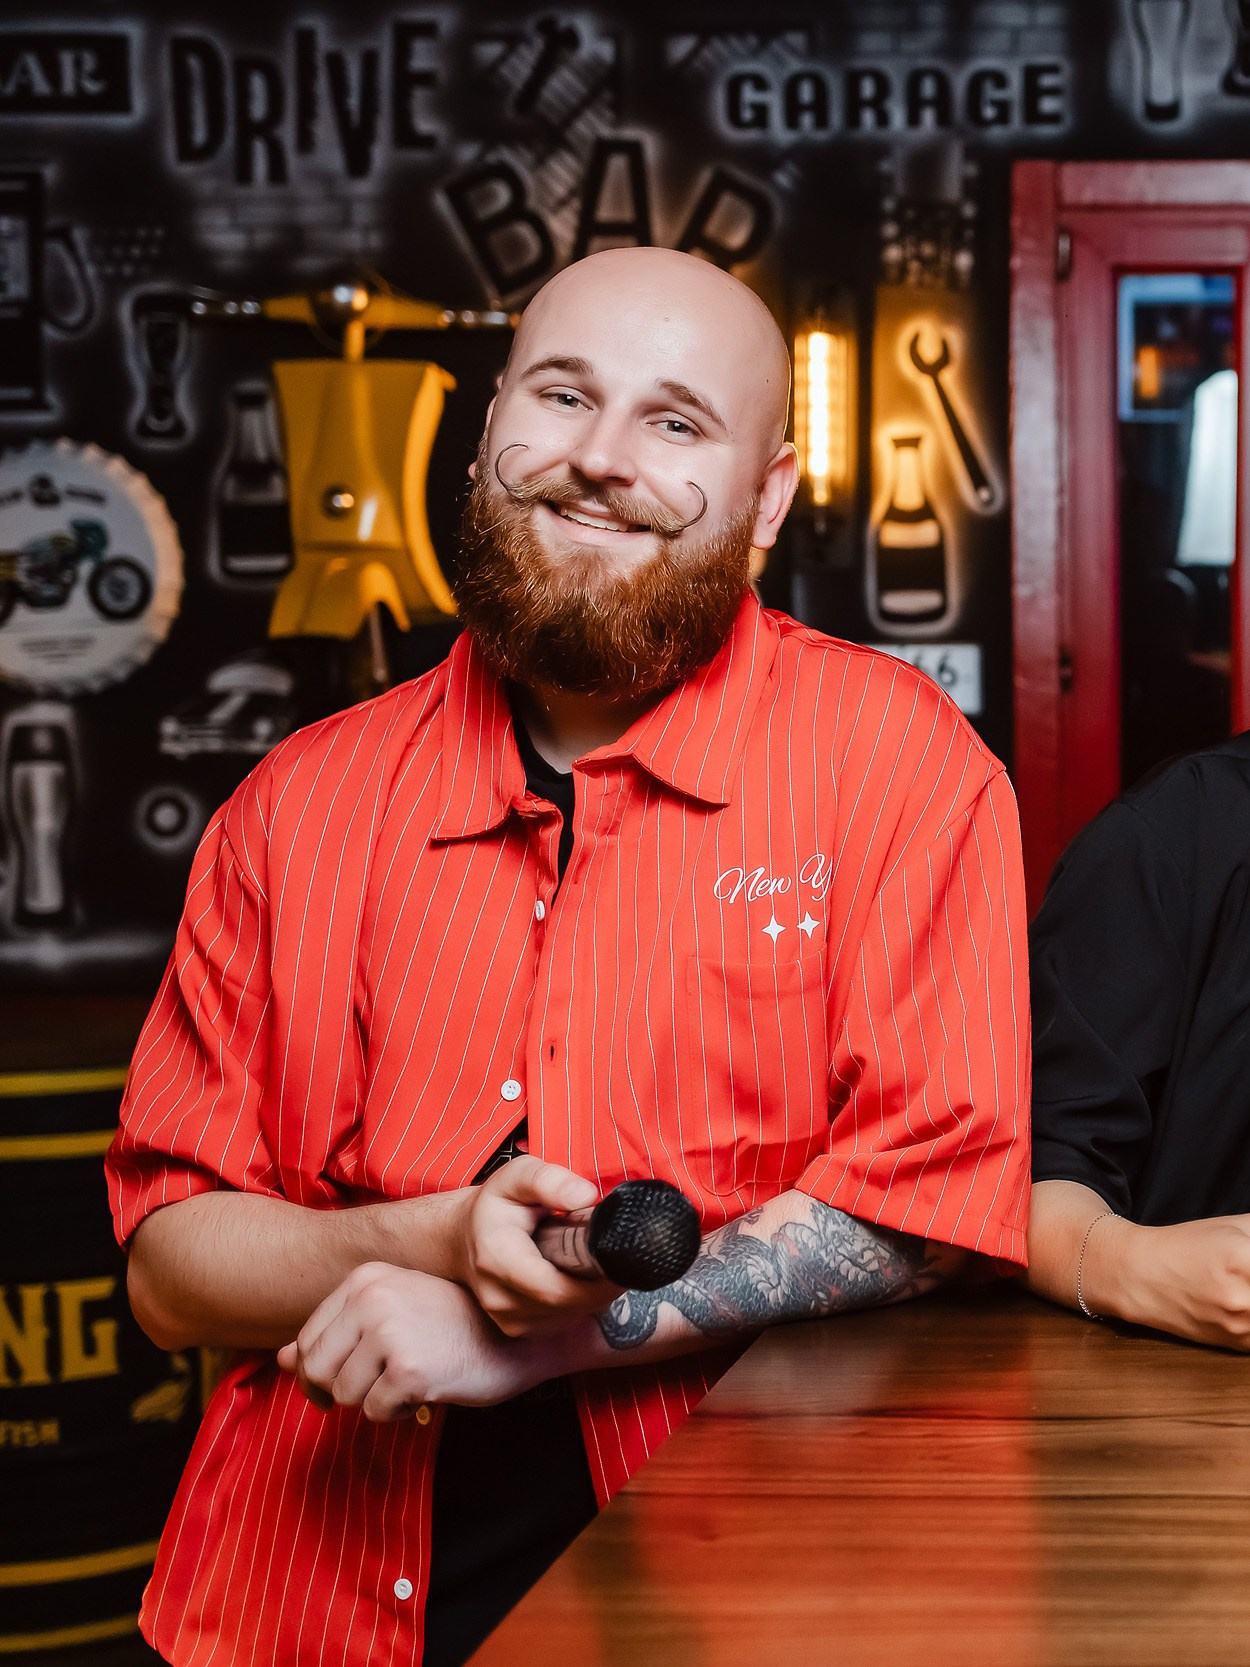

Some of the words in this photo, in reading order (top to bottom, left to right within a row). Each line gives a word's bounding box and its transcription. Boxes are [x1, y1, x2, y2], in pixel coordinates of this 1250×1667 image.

[169, 21, 438, 186] DRIVE
[727, 62, 1062, 131] GARAGE
[713, 866, 792, 904] New
